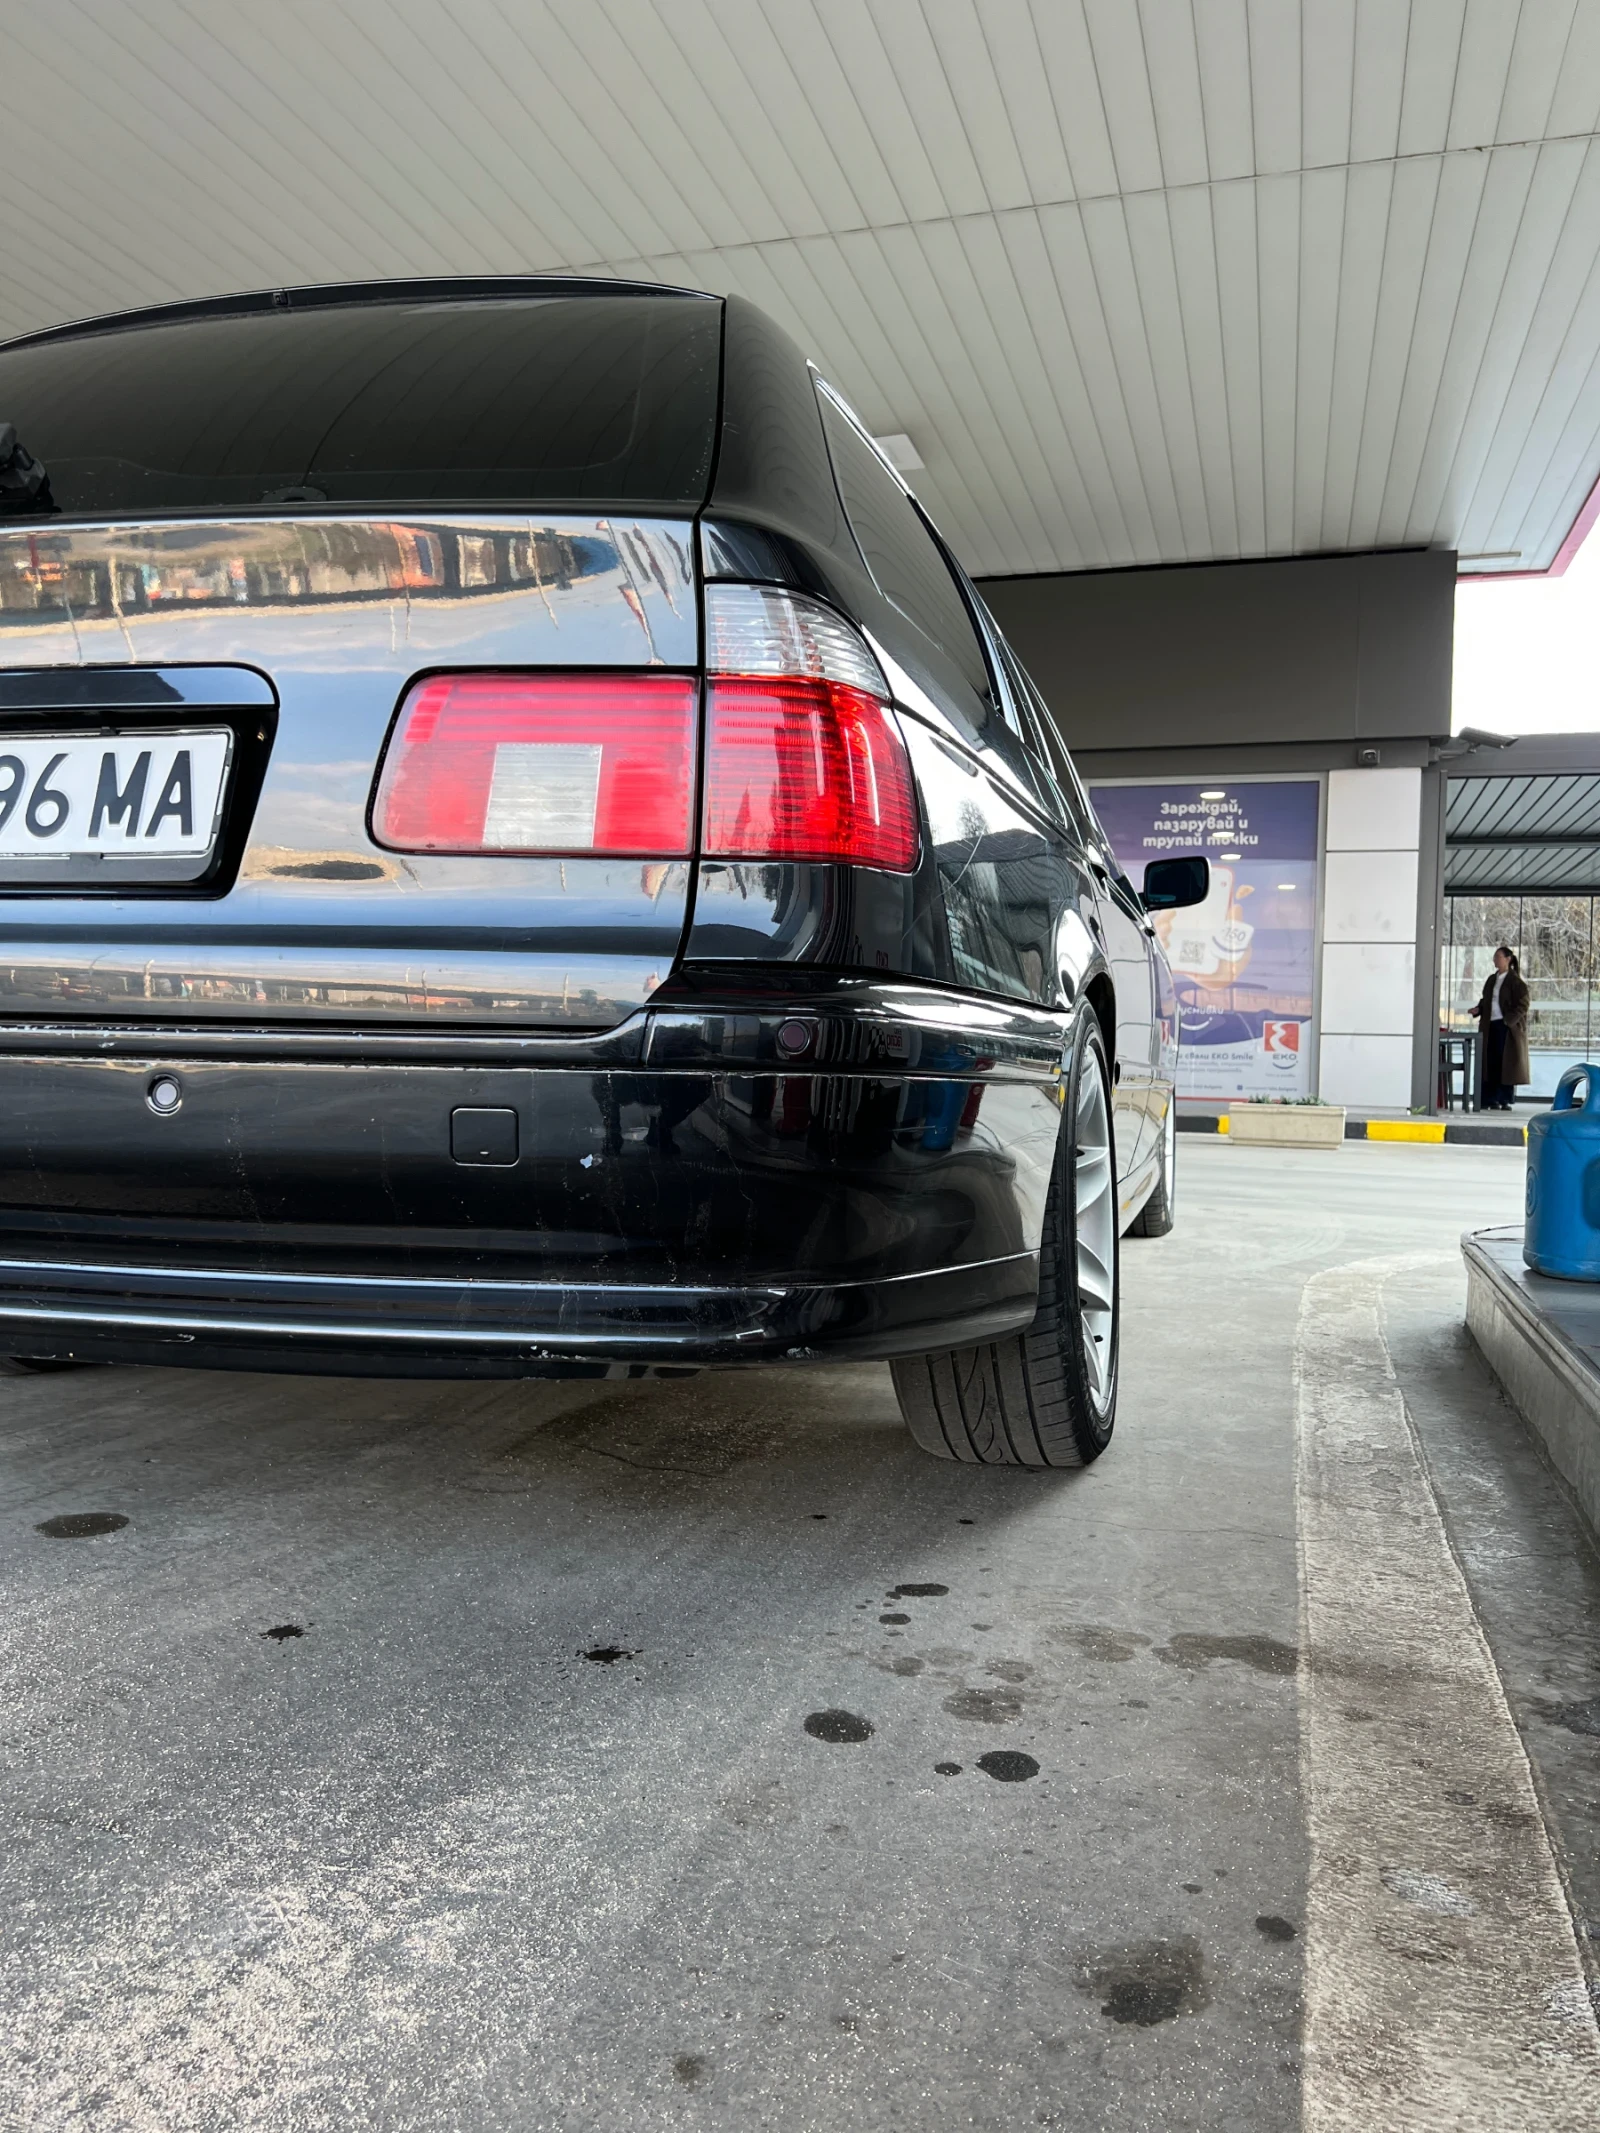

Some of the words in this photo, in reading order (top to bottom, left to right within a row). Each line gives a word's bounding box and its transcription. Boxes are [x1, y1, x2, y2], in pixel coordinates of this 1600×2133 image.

[88, 750, 194, 838] MA
[1160, 799, 1243, 816] Зареждай,
[1154, 815, 1234, 832] пазарувай
[1238, 819, 1248, 829] и
[1143, 832, 1202, 849] трупай
[1206, 832, 1258, 846] точки
[1212, 1052, 1229, 1060] EKO
[1231, 1052, 1254, 1060] Smile
[1272, 1053, 1297, 1061] EKO
